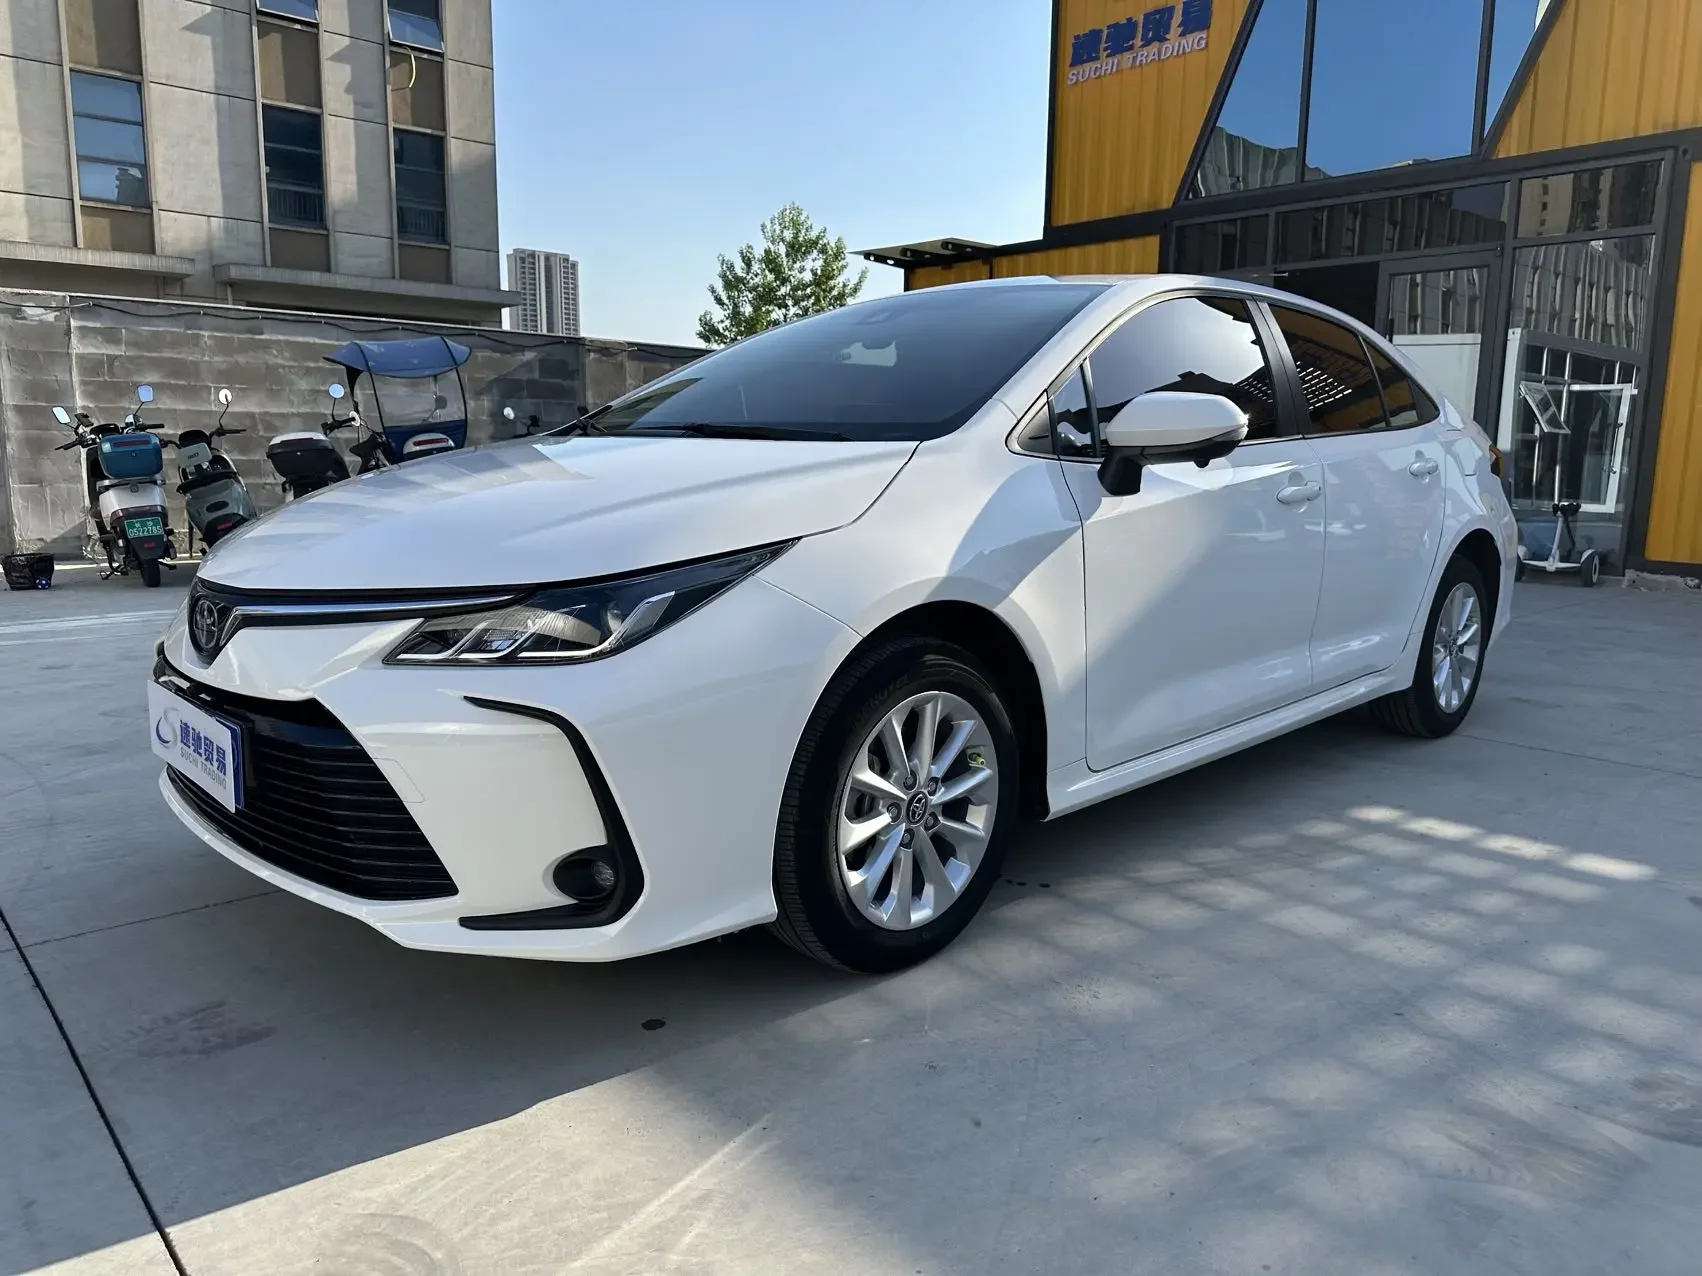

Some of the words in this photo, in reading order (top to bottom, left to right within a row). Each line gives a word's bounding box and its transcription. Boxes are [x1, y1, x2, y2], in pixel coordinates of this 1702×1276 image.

[1067, 58, 1119, 85] SUCHI
[1123, 33, 1208, 69] TRADING
[128, 526, 162, 536] 0522785
[180, 720, 226, 776] 速驰贸易
[180, 748, 199, 769] SUCHI
[200, 761, 227, 789] TRADING
